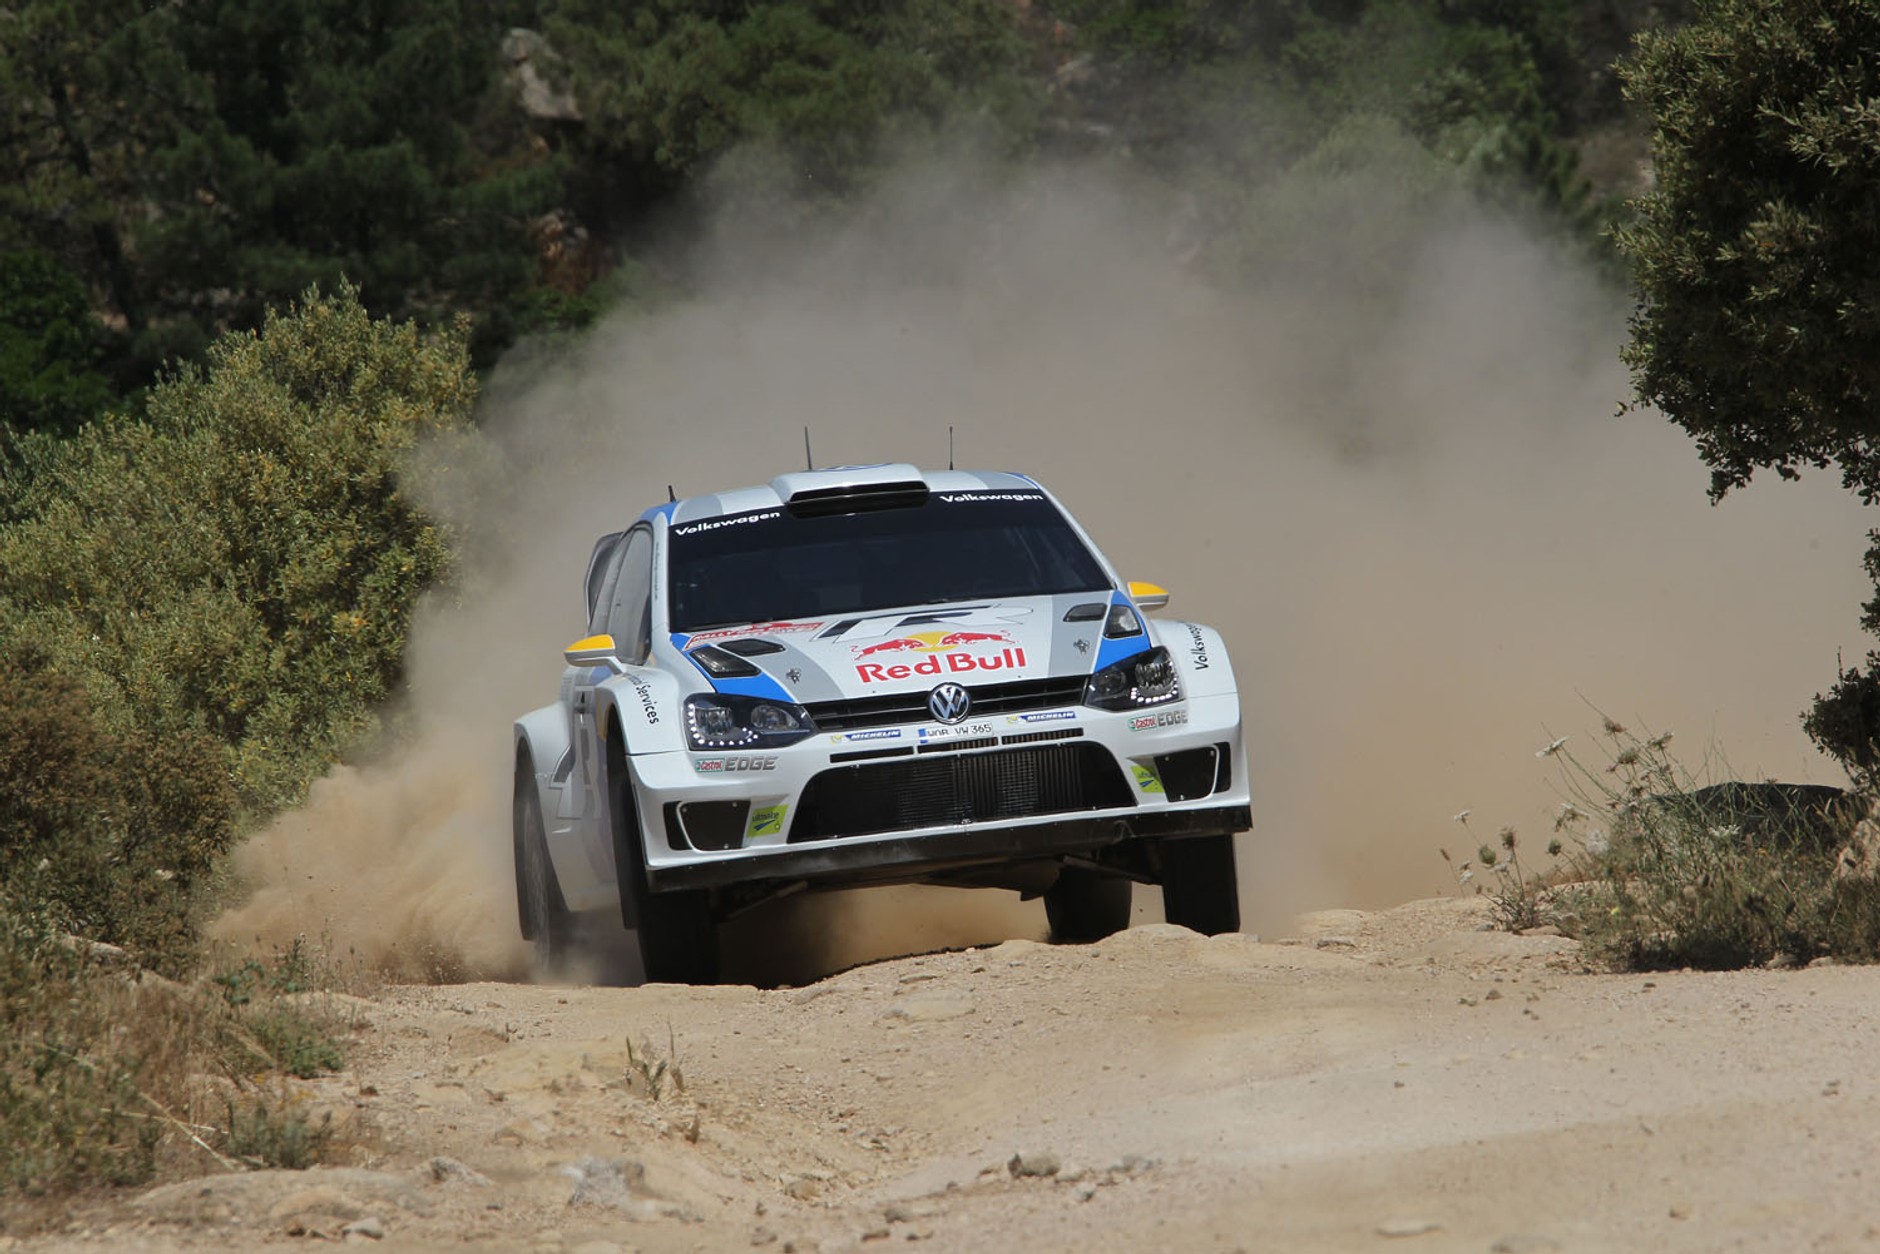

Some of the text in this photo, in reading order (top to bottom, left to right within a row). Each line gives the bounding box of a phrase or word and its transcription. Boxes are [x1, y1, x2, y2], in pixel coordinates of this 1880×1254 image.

[939, 494, 1043, 503] Volkswagen
[675, 511, 780, 536] Volkswagen
[855, 648, 1026, 683] Red Bull
[1026, 711, 1076, 722] MICHELIN
[1157, 710, 1188, 726] EDGE
[850, 729, 900, 741] MICHELIN
[971, 724, 992, 734] 365
[724, 756, 778, 771] EDGE
